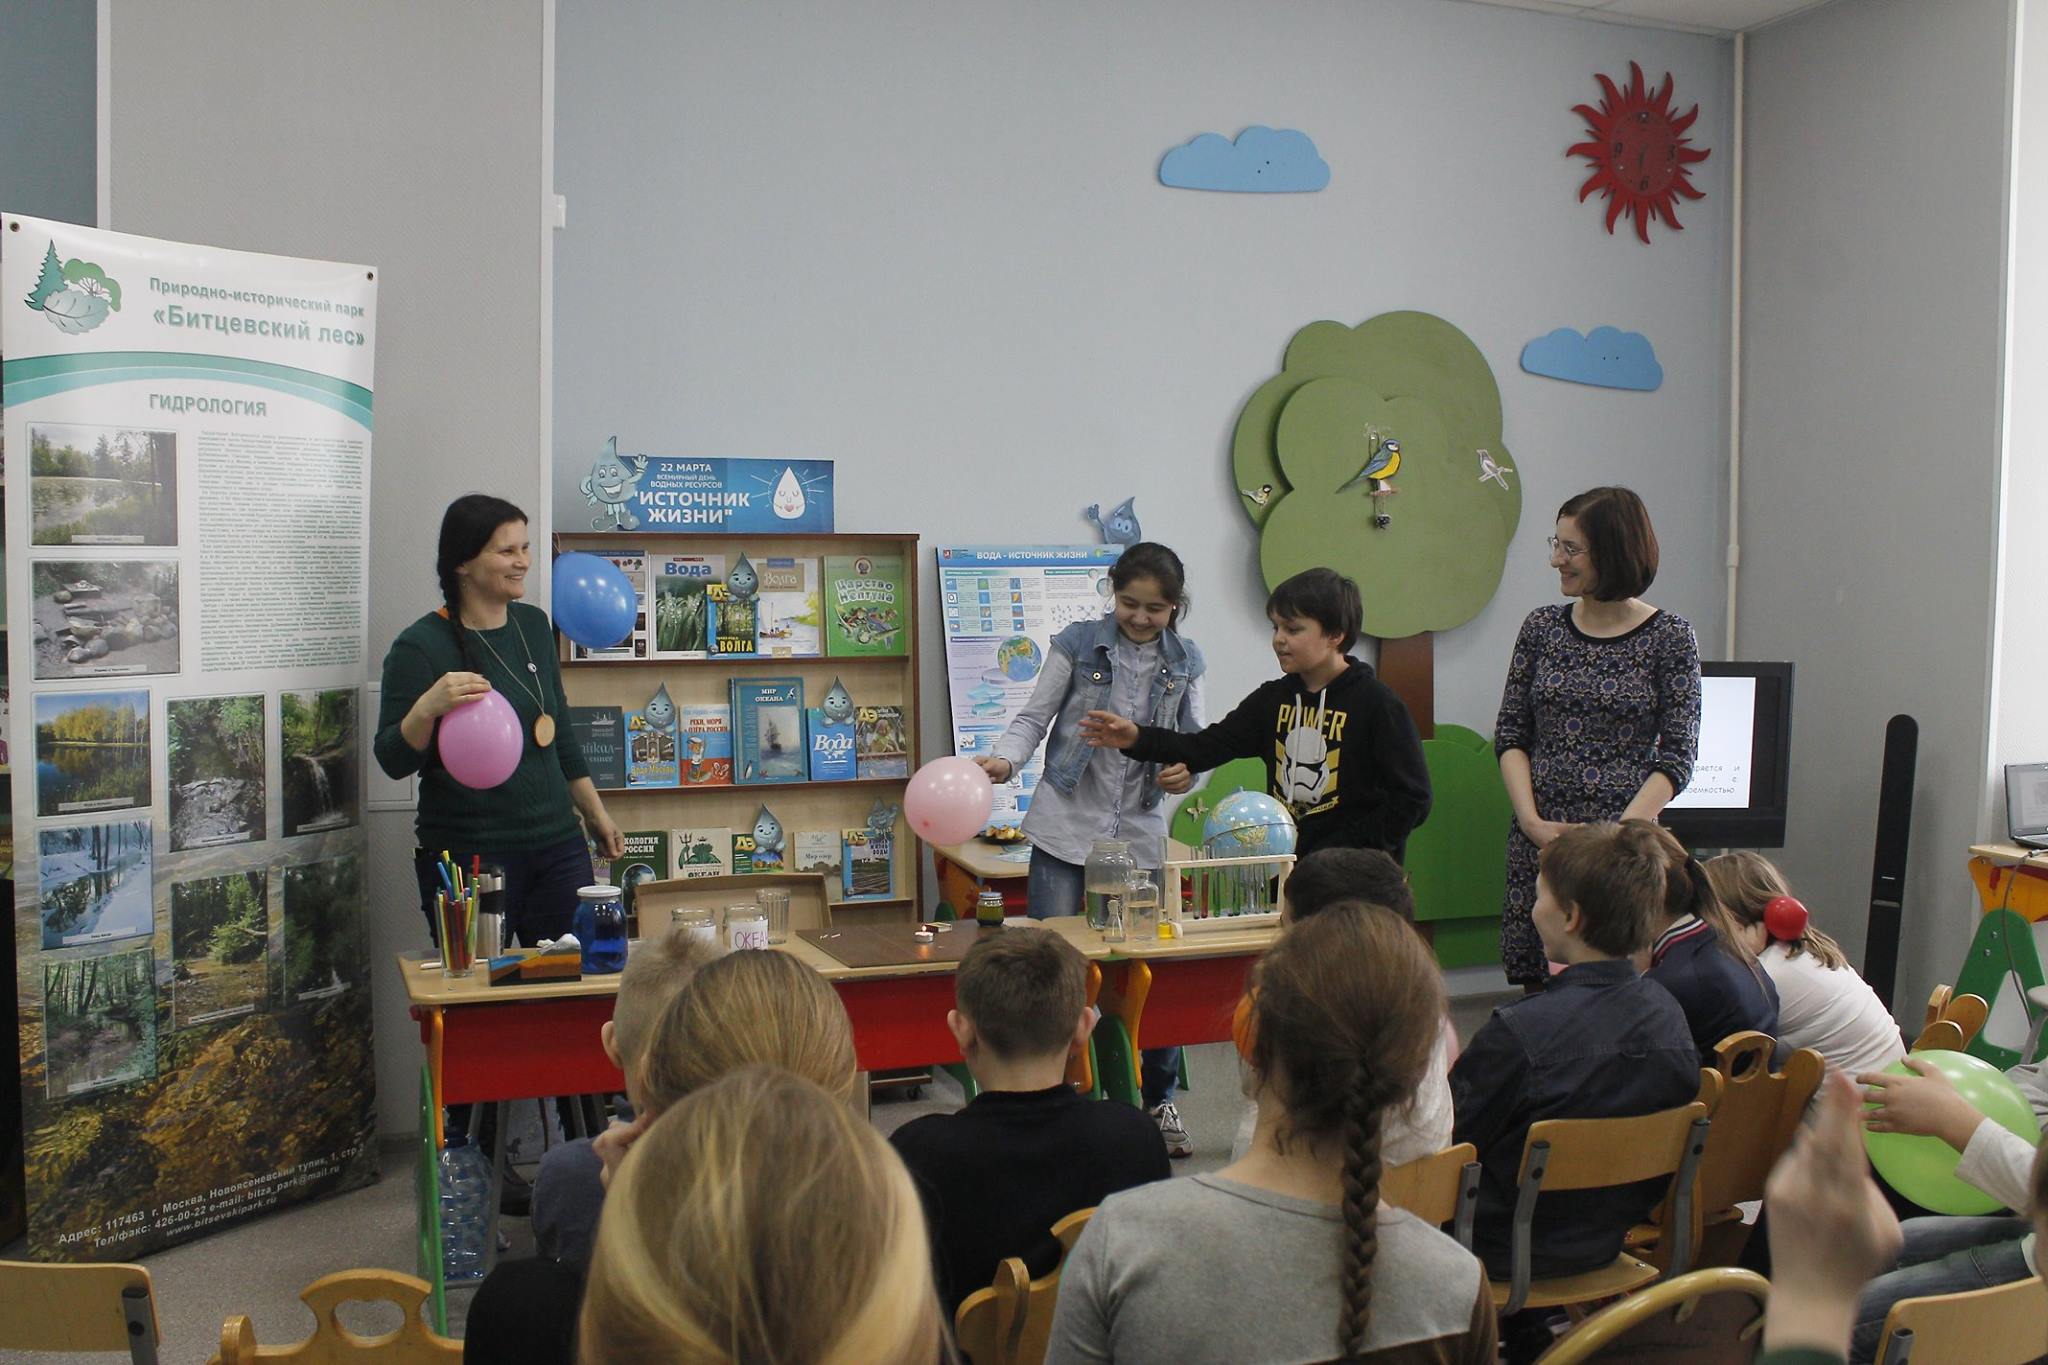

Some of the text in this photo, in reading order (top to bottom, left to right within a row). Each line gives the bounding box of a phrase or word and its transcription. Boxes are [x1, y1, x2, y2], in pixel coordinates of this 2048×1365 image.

[150, 277, 364, 318] Природно-исторический парк
[153, 304, 365, 346] «Битцевский лес»
[149, 394, 267, 417] ГИДРОЛОГИЯ
[660, 463, 712, 472] 22 МАРТА
[650, 480, 723, 489] ВОДНЫХ РЕСУРСОВ
[648, 508, 733, 523] ЖИЗНИ"
[977, 551, 1001, 560] ВОДА
[1009, 551, 1054, 560] ИСТОЧНИК
[1055, 550, 1088, 559] ЖИЗНИ
[664, 562, 712, 577] Вода
[837, 580, 894, 591] Царство
[838, 591, 893, 603] Нептуна
[720, 641, 753, 652] ВОЛГА
[814, 733, 853, 750] Вода
[624, 837, 659, 845] КОЛОГИЯ
[624, 845, 655, 853] РОССИИ
[59, 1225, 102, 1244] Адрес:
[105, 1211, 145, 1230] 117463
[151, 1208, 159, 1217] г.
[162, 1194, 206, 1213] Москва,
[94, 1224, 152, 1248] Тел/факс:
[154, 1205, 206, 1229] 426-00-22
[209, 1194, 245, 1212] e-mail:
